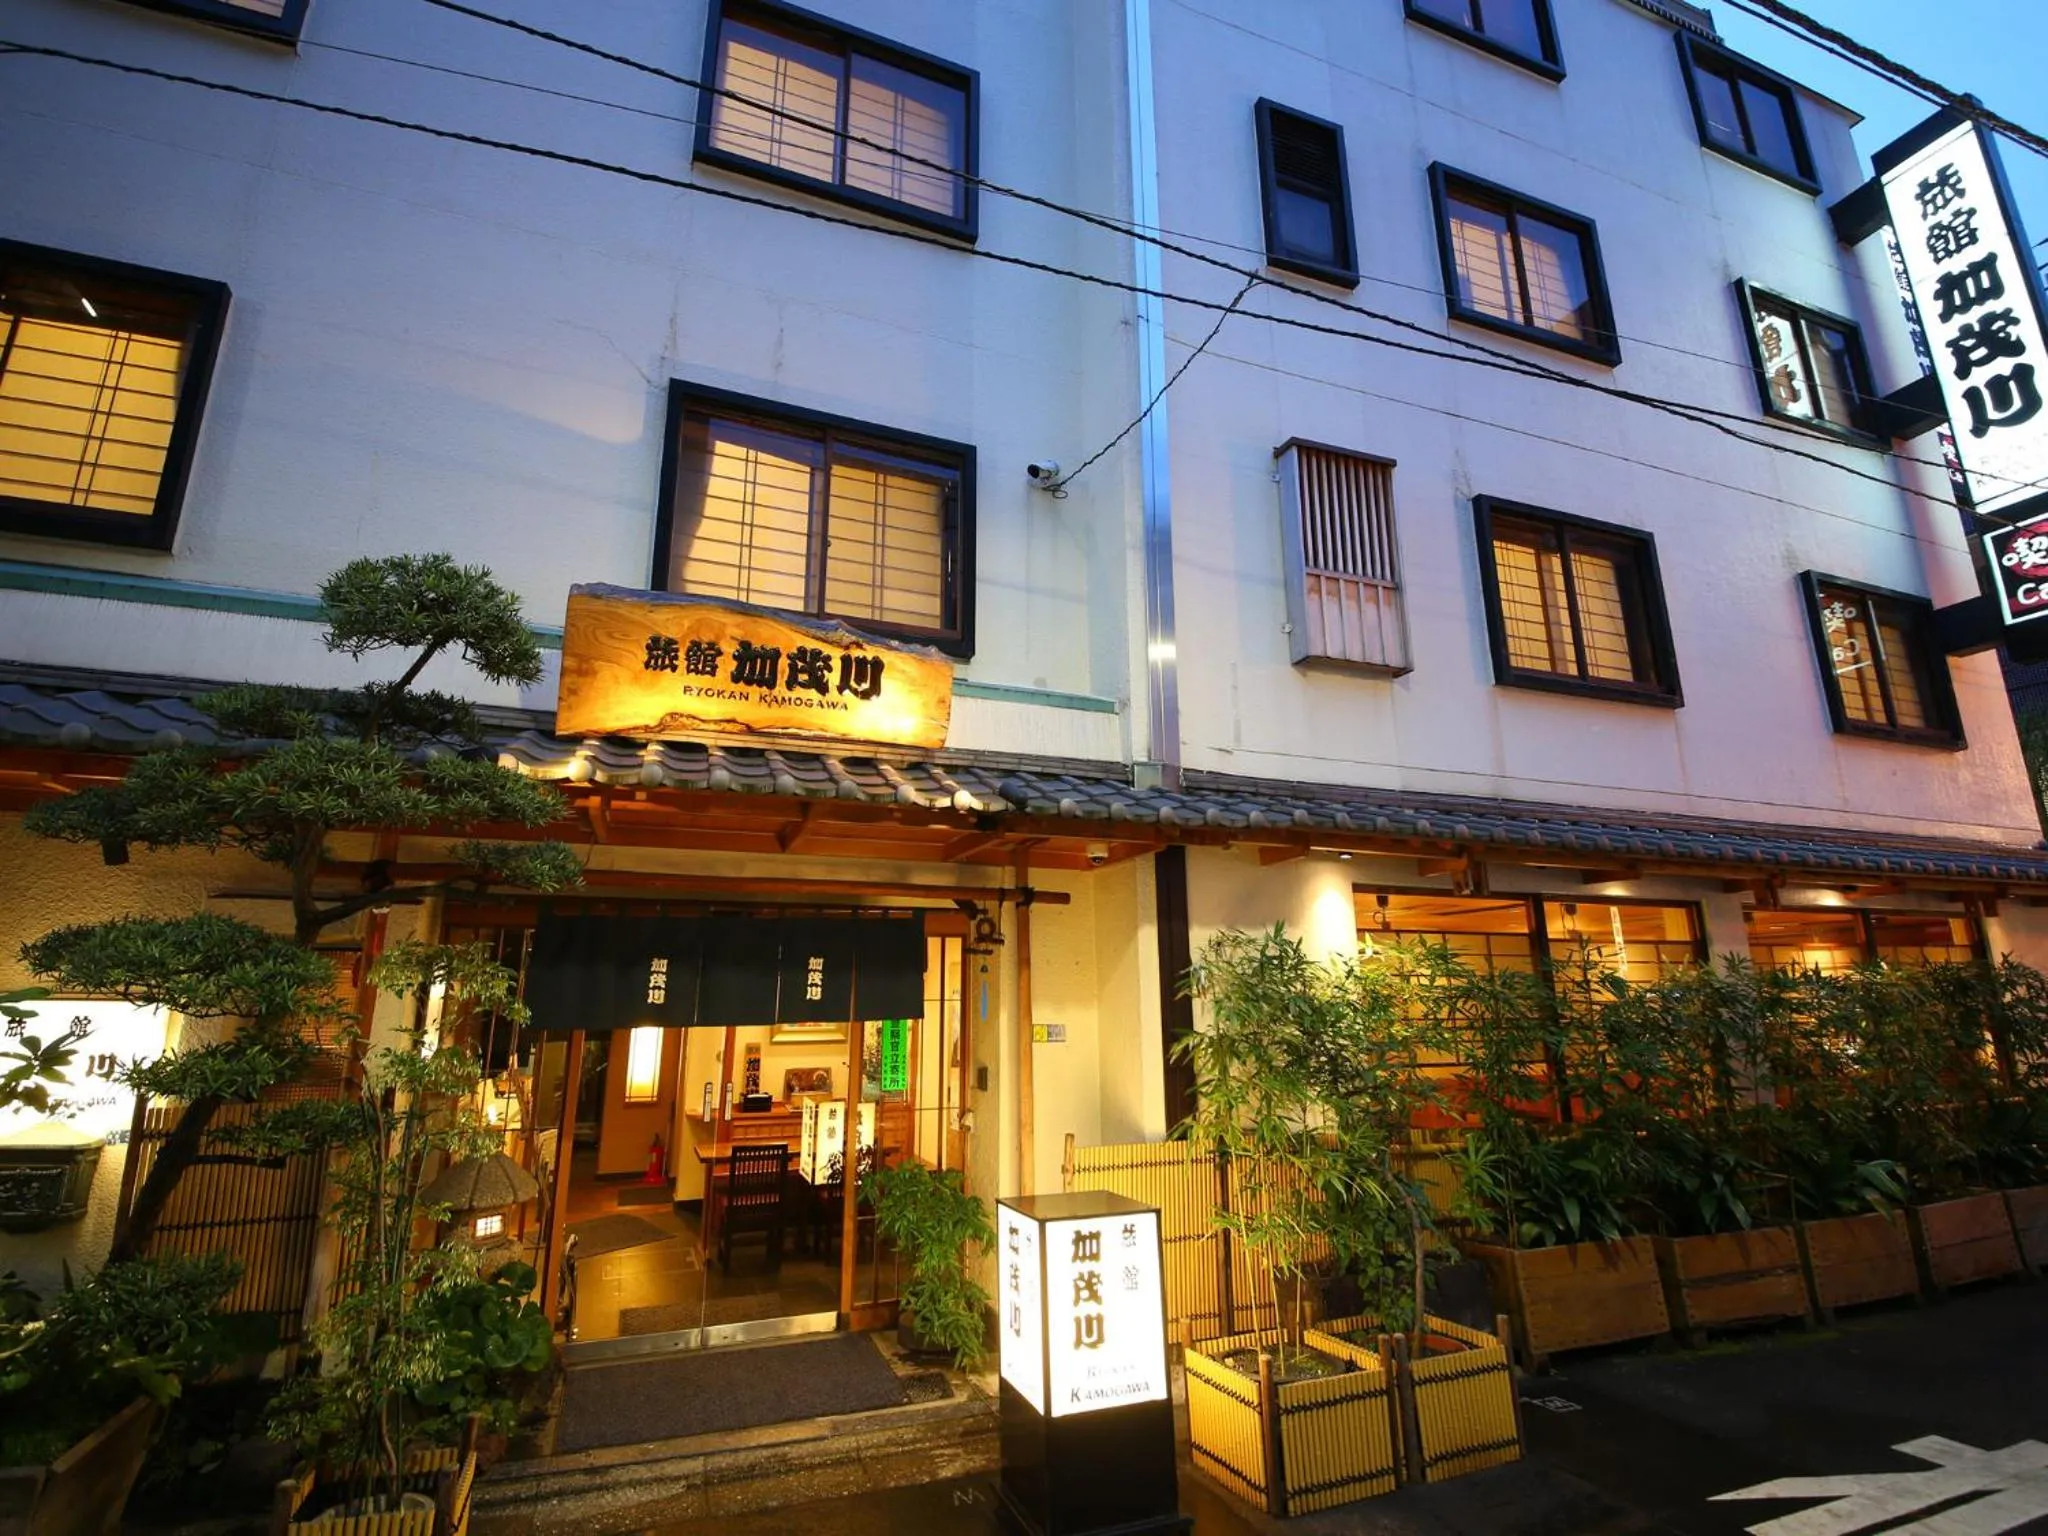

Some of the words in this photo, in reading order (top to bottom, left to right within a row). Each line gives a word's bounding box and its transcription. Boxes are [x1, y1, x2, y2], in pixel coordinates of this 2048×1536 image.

[1915, 162, 1979, 265] 旅館
[1933, 252, 2043, 438] 加茂川
[644, 634, 723, 677] 旅館
[730, 640, 885, 700] 加茂川
[683, 684, 749, 701] RYOKAN
[758, 692, 849, 712] KAMOGAWA
[647, 957, 668, 1005] 加茂川
[807, 956, 824, 1001] 加茂川
[1071, 1230, 1105, 1350] 加茂川
